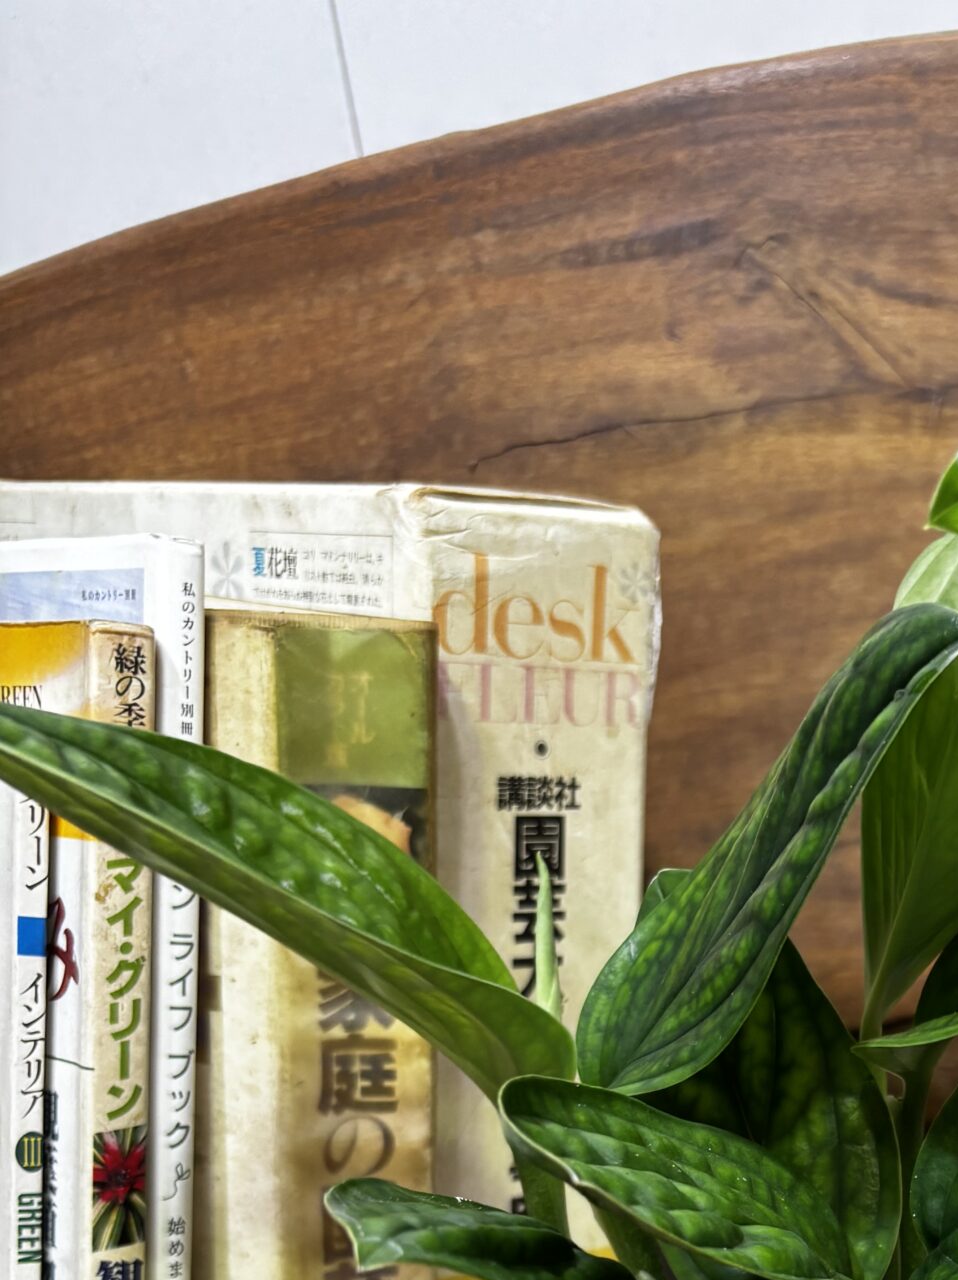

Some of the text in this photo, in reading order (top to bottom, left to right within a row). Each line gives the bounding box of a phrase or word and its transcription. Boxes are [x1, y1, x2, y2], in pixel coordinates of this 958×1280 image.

[180, 582, 196, 736] 私のカントリー別冊
[433, 552, 640, 664] desk
[0, 685, 42, 709] REEN
[20, 797, 49, 890] リーン
[497, 776, 581, 812] 講談社
[106, 857, 146, 1121] マイ・グリーン
[20, 972, 47, 1119] インテリア
[17, 1193, 42, 1264] GREEN
